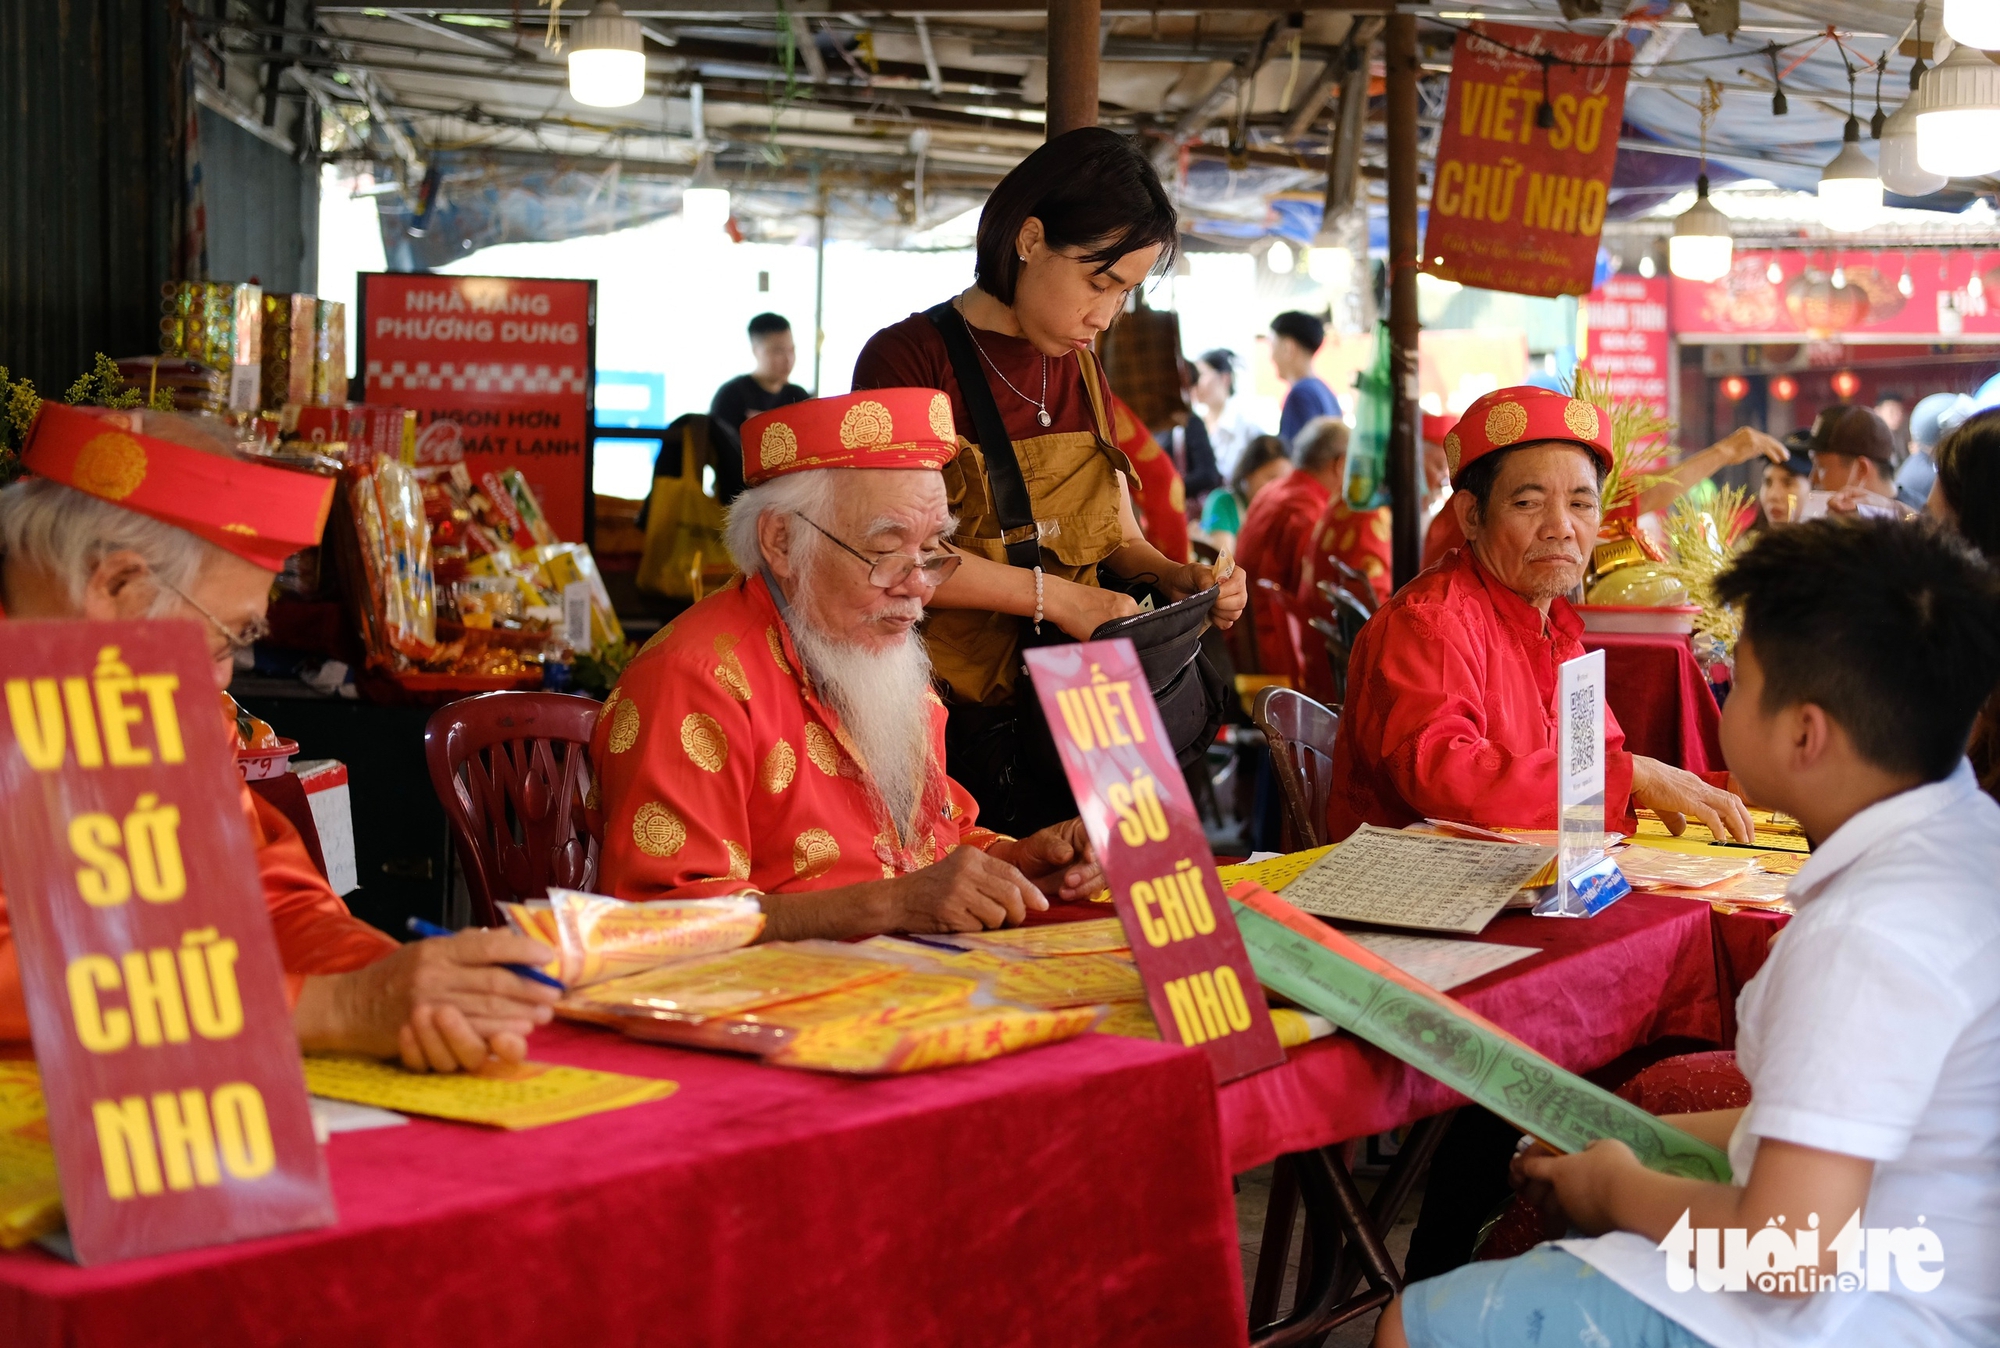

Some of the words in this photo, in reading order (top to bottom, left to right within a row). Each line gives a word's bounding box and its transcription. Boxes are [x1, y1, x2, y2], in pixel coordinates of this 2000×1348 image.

[1459, 70, 1543, 145] VIẾT
[1436, 156, 1525, 223] CHỮ
[1522, 171, 1607, 237] NHO
[405, 288, 464, 313] NHÀ
[501, 321, 579, 344] DUNG
[508, 407, 560, 429] HƠN
[515, 440, 580, 460] LẠNH
[4, 645, 186, 771] VIẾT
[1056, 663, 1147, 752] VIẾT
[1107, 767, 1170, 848] SỚ
[68, 793, 187, 908] SỚ
[1130, 858, 1216, 948] CHỮ
[66, 924, 244, 1055] CHỮ
[1163, 965, 1252, 1047] NHO
[92, 1082, 276, 1201] NHO
